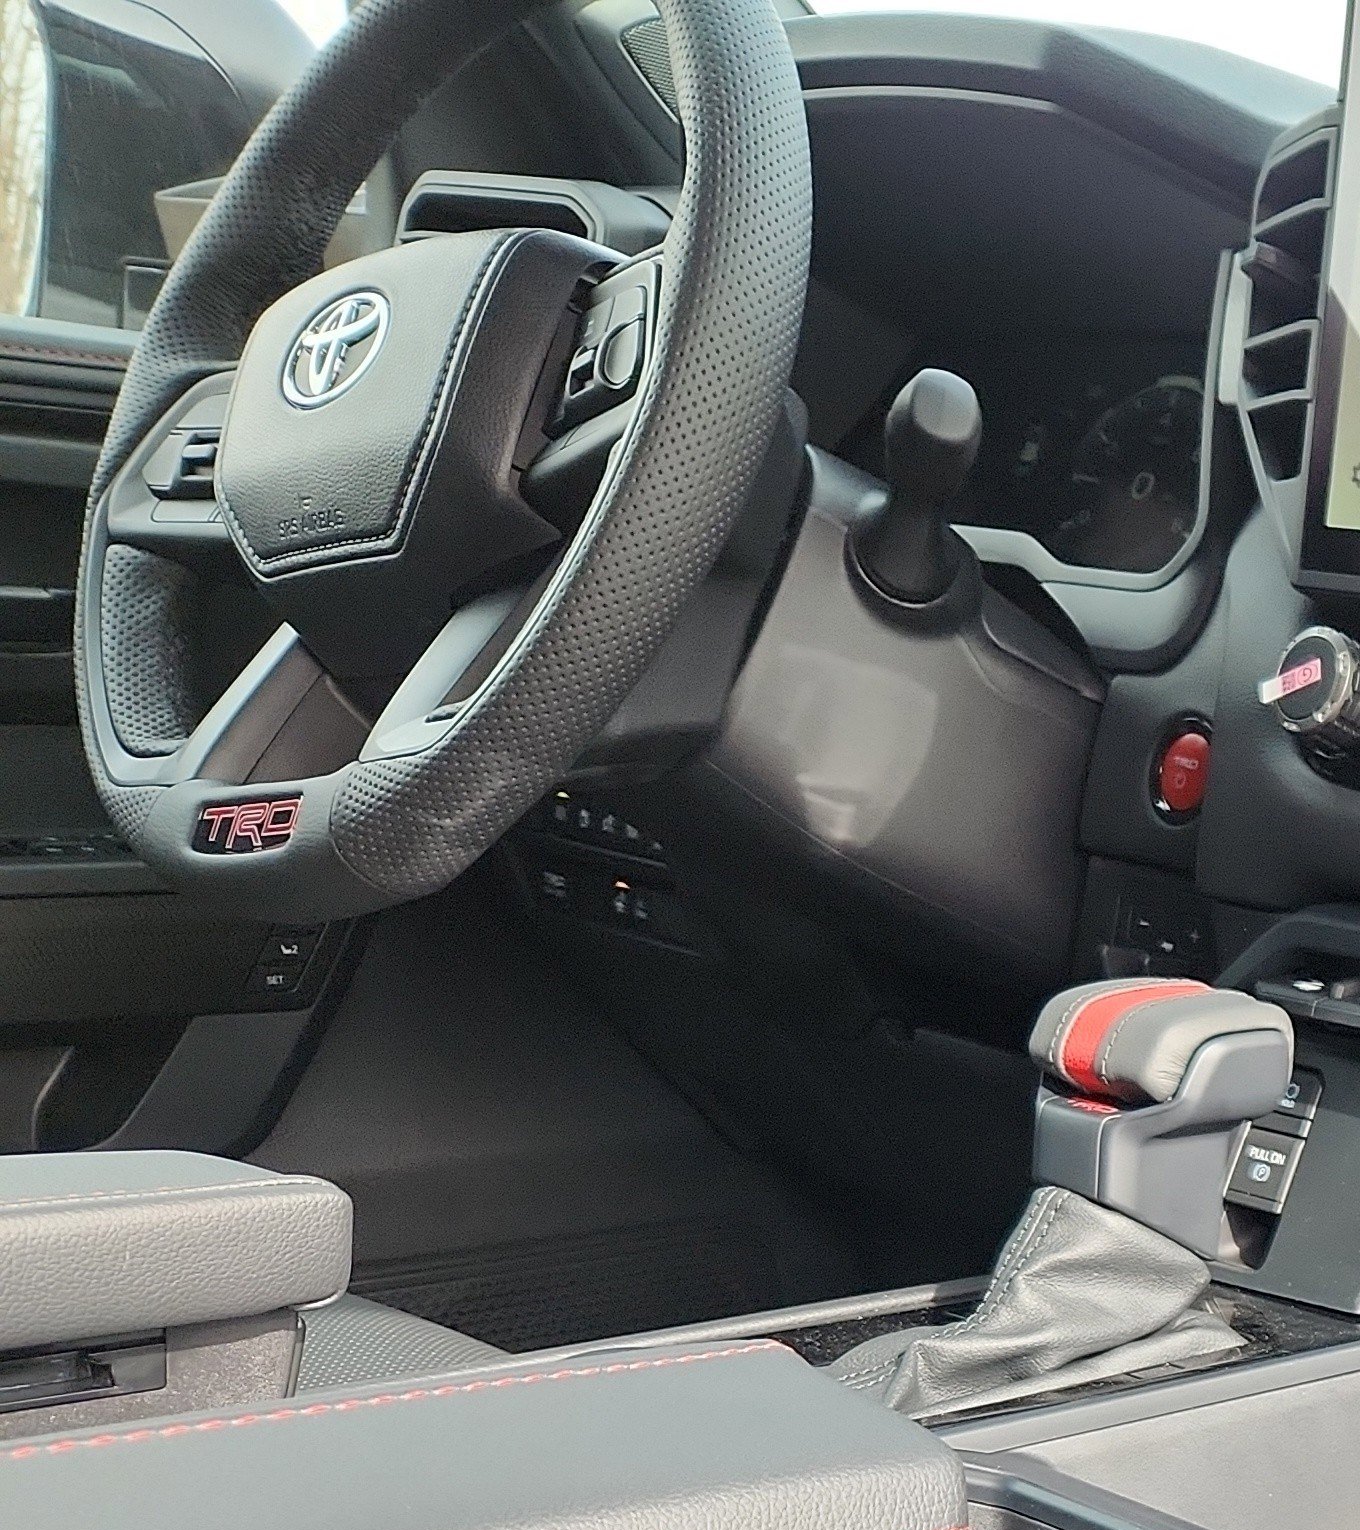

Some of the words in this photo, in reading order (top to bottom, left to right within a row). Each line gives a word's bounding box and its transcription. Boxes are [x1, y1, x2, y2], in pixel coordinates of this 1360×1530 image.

[203, 799, 301, 849] TRD
[1249, 1144, 1271, 1163] PULL
[1271, 1152, 1287, 1165] ON
